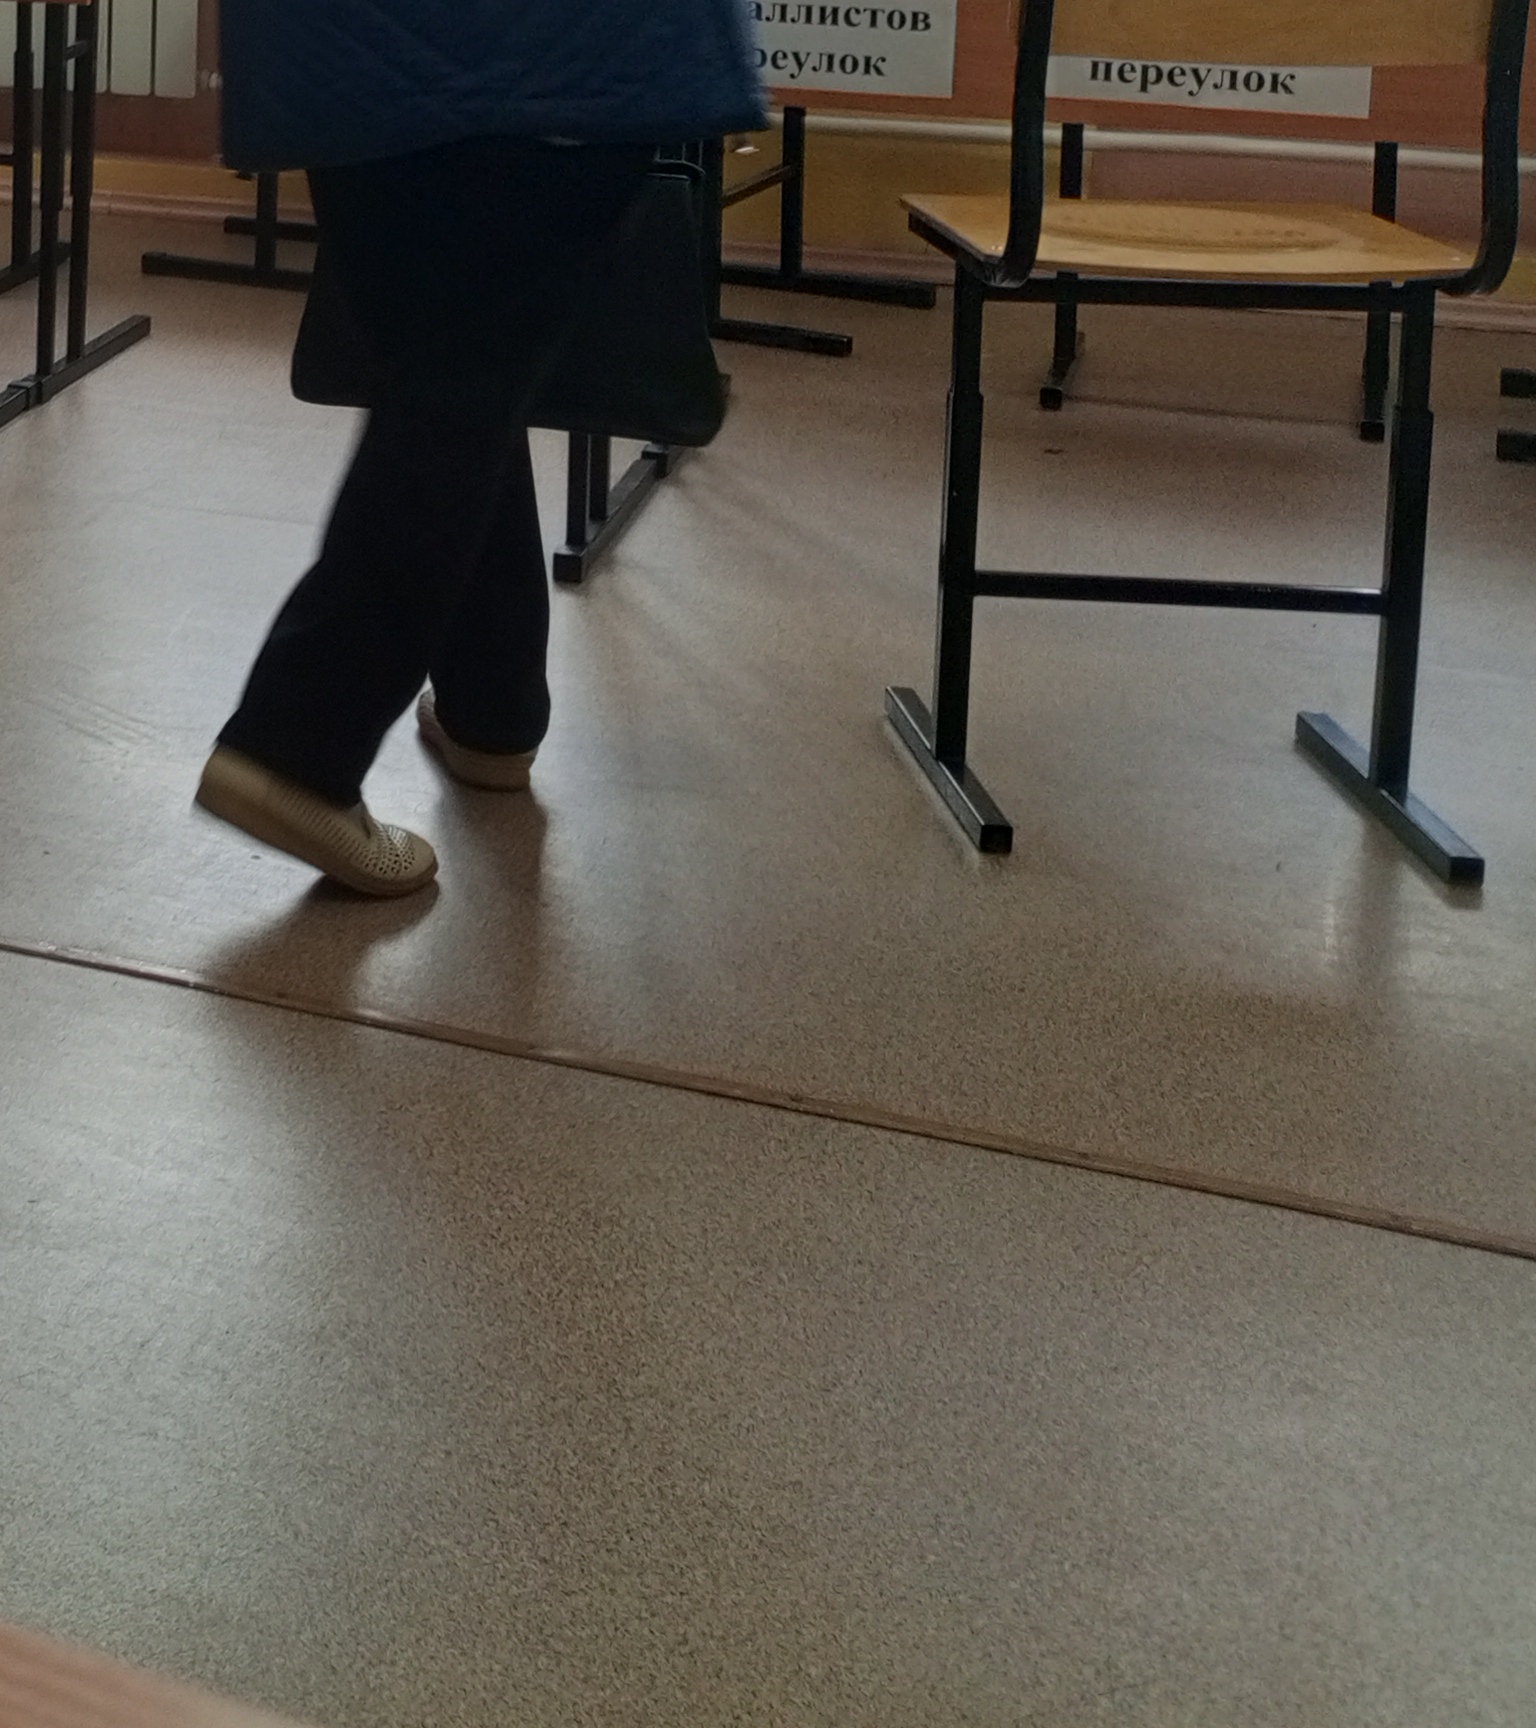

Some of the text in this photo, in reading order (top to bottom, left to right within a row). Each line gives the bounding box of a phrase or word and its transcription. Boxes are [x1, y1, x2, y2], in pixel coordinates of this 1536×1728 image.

[747, 1, 932, 32] аллистов
[753, 47, 888, 79] реулок
[1089, 60, 1295, 97] переулок
